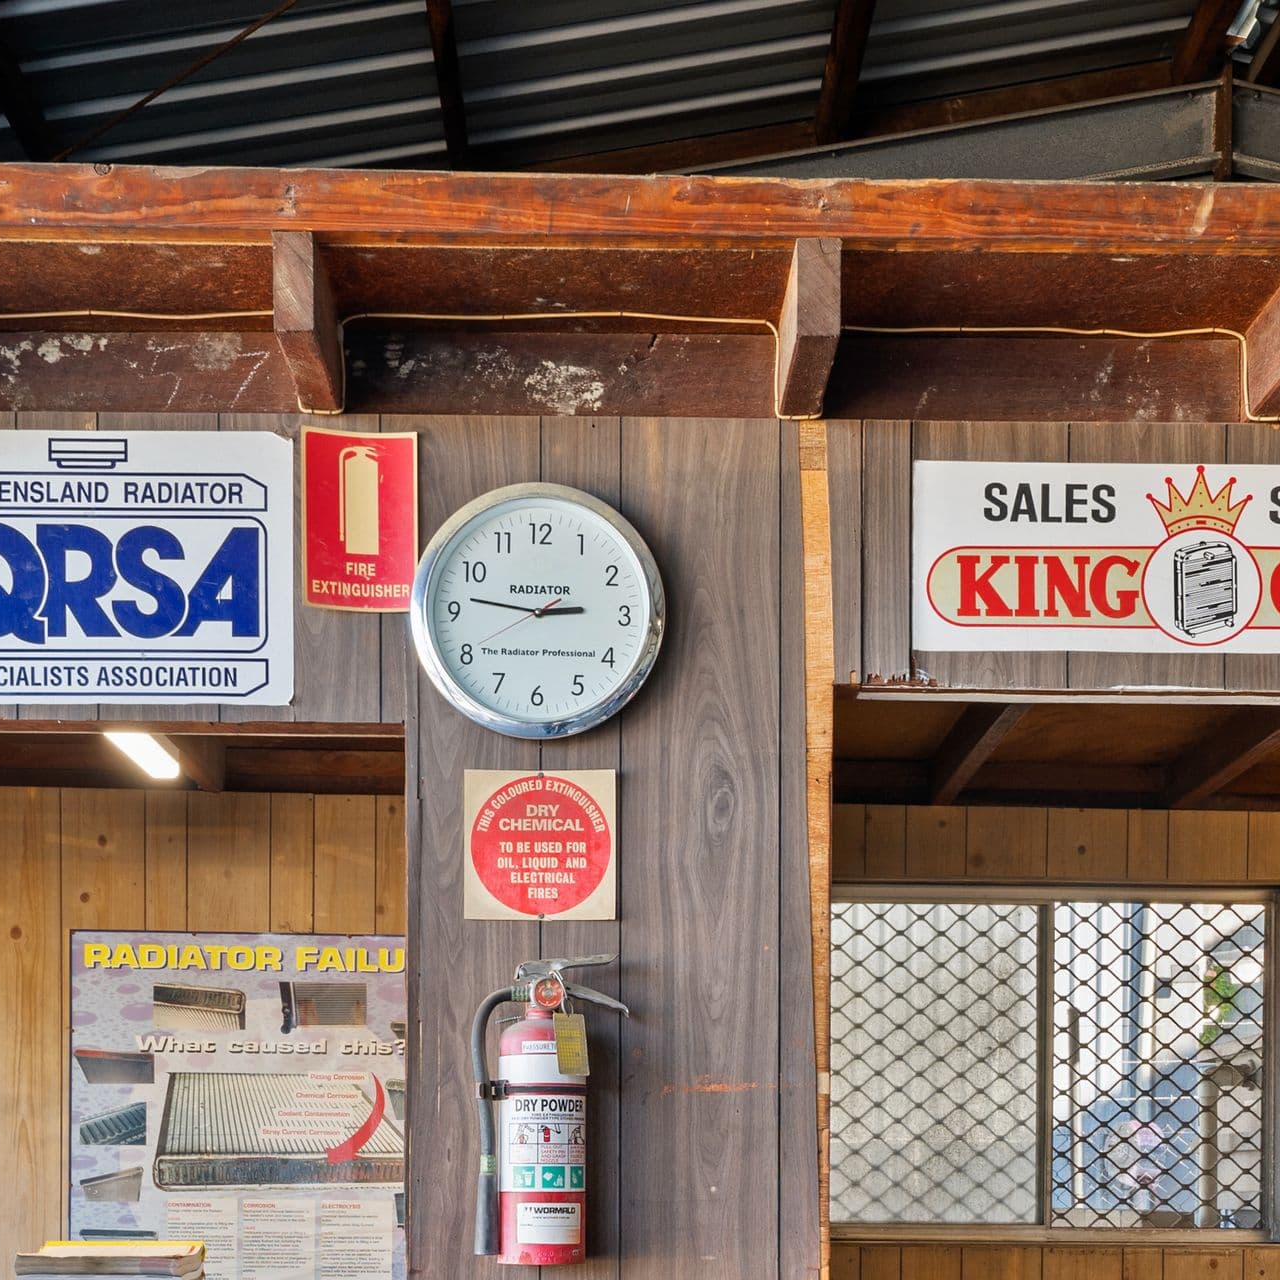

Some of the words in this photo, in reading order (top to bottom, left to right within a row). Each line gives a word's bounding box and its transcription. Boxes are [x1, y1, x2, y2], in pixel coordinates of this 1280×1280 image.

[123, 481, 244, 505] RADIATOR
[983, 482, 1117, 524] SALES
[494, 531, 512, 554] 11
[529, 523, 552, 545] 12
[576, 533, 584, 555] 1
[346, 562, 376, 578] FIRE
[462, 561, 487, 583] 10
[605, 564, 619, 587] 2
[312, 579, 411, 598] EXTINGUISHER
[509, 584, 571, 596] RADIATOR
[956, 554, 1140, 620] KING
[447, 600, 461, 623] 9
[618, 604, 631, 627] 3
[460, 643, 474, 665] 8
[481, 647, 498, 656] The
[501, 647, 540, 657] Radiator
[542, 648, 596, 658] Professional
[601, 646, 616, 668] 4
[96, 665, 238, 688] ASSOCIATION
[492, 672, 506, 695] 7
[570, 674, 584, 696] 5
[531, 685, 544, 707] 6
[477, 809, 495, 833] THIS
[491, 779, 543, 811] COLOURED
[545, 779, 606, 833] EXTINGUISHER
[526, 804, 560, 817] DRY
[498, 818, 585, 832] CHEMICAL
[499, 842, 512, 853] TO
[517, 842, 530, 853] BE
[534, 842, 563, 854] USED
[566, 842, 587, 854] FOR
[522, 857, 558, 869] LIQUID
[566, 857, 587, 869] AND
[510, 872, 576, 884] ELECTRICAL
[527, 887, 558, 899] FIRES
[83, 943, 284, 971] RADIATOR
[135, 1034, 217, 1055] What
[228, 1038, 328, 1056] caused
[339, 1038, 406, 1057] this?
[333, 1073, 365, 1081] Corrosion
[326, 1092, 359, 1100] Corrosion
[515, 1098, 538, 1112] DRY
[541, 1098, 584, 1112] POWDER
[278, 1110, 303, 1118] Coolant
[308, 1129, 341, 1137] Corrosion
